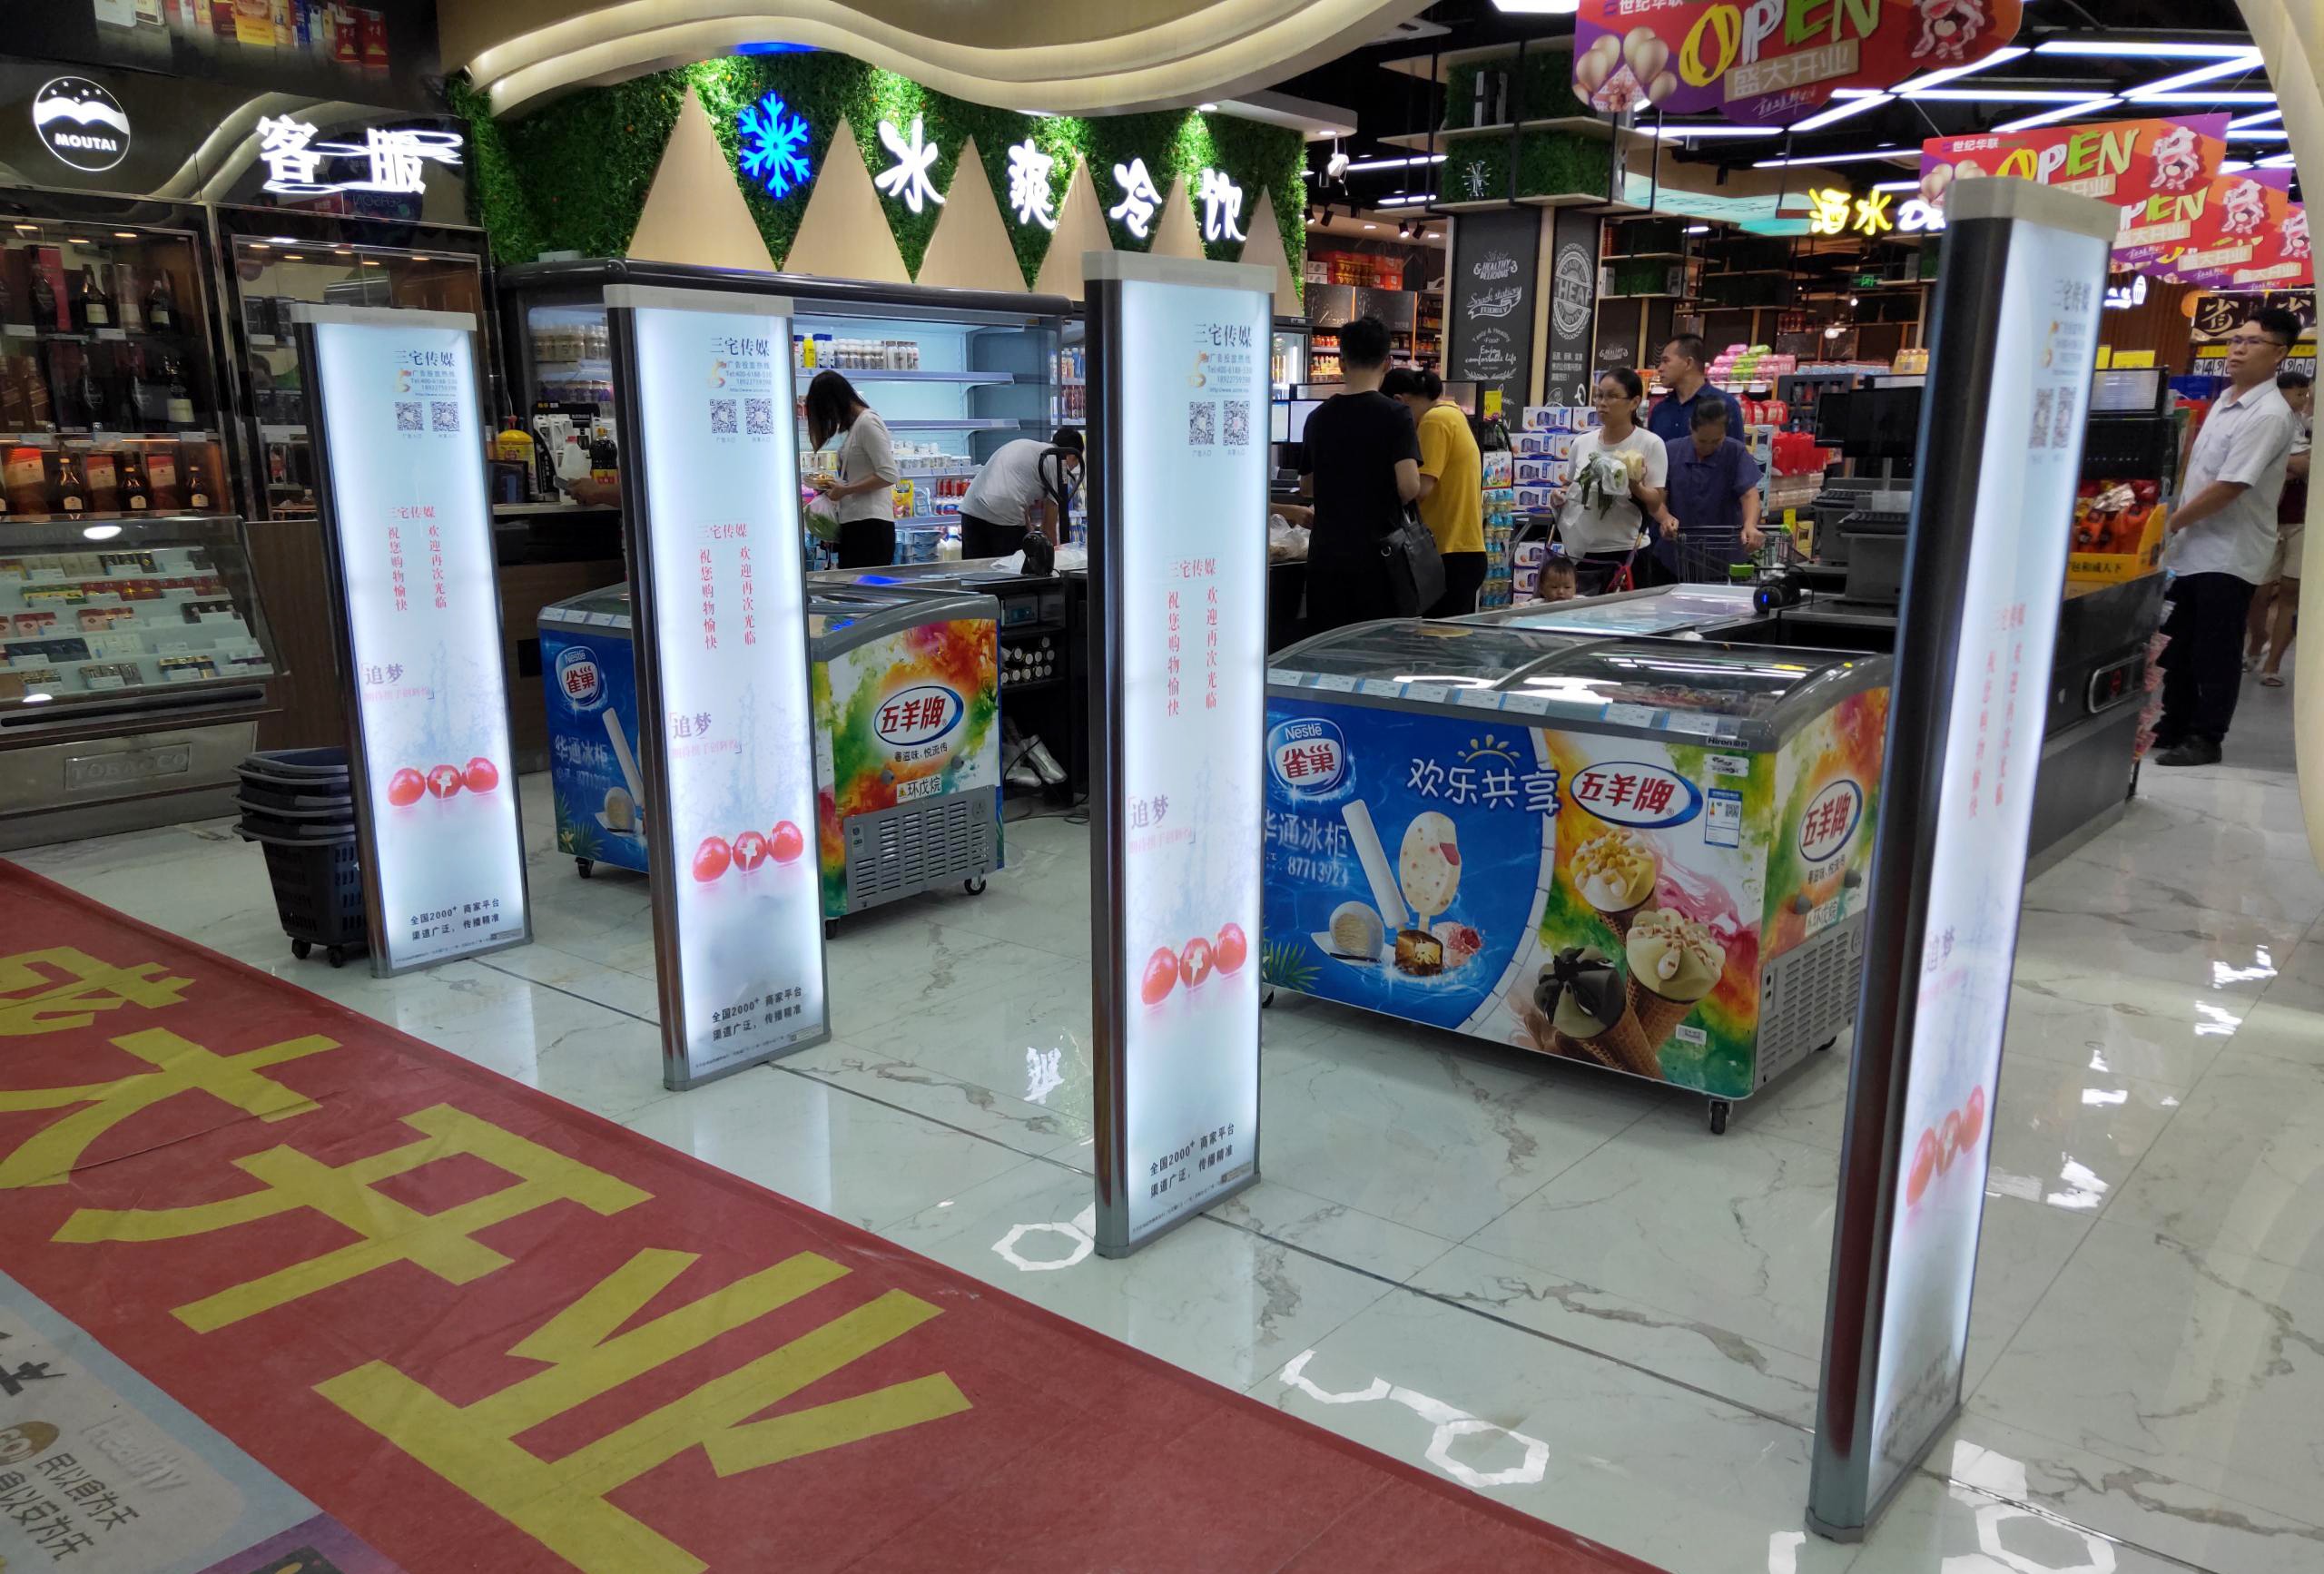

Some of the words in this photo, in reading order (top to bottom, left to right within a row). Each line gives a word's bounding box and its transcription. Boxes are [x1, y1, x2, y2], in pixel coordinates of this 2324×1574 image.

[1733, 42, 1849, 98] 盛大开业
[54, 133, 117, 152] MOUTAI
[1809, 188, 1893, 236] 酒水
[711, 337, 770, 357] 三宅传媒
[1193, 323, 1252, 349] 三宅传媒
[1481, 345, 1502, 358] Enjoy
[392, 349, 455, 367] 三宅传媒
[698, 523, 747, 539] 三宅传媒
[1169, 558, 1216, 579] 三宅传媒
[700, 548, 717, 650] 祝您购物愉快
[741, 546, 756, 646] 欢迎再次光临
[1167, 591, 1180, 717] 祝您购物愉快
[1206, 585, 1218, 711] 欢迎再次光临
[365, 663, 404, 685] 追梦
[566, 665, 596, 694] 雀巢
[673, 712, 712, 740] 追梦
[881, 695, 946, 733] 五羊牌
[555, 735, 608, 768] 华通冰柜
[1282, 743, 1335, 779] 雀巢
[908, 777, 941, 797] 环戊烷
[1407, 758, 1561, 815] 欢乐共享
[1578, 772, 1676, 815] 五羊牌
[1131, 794, 1168, 830] 追梦
[1802, 792, 1852, 847] 五羊牌
[34, 1452, 140, 1531] 民以食为天
